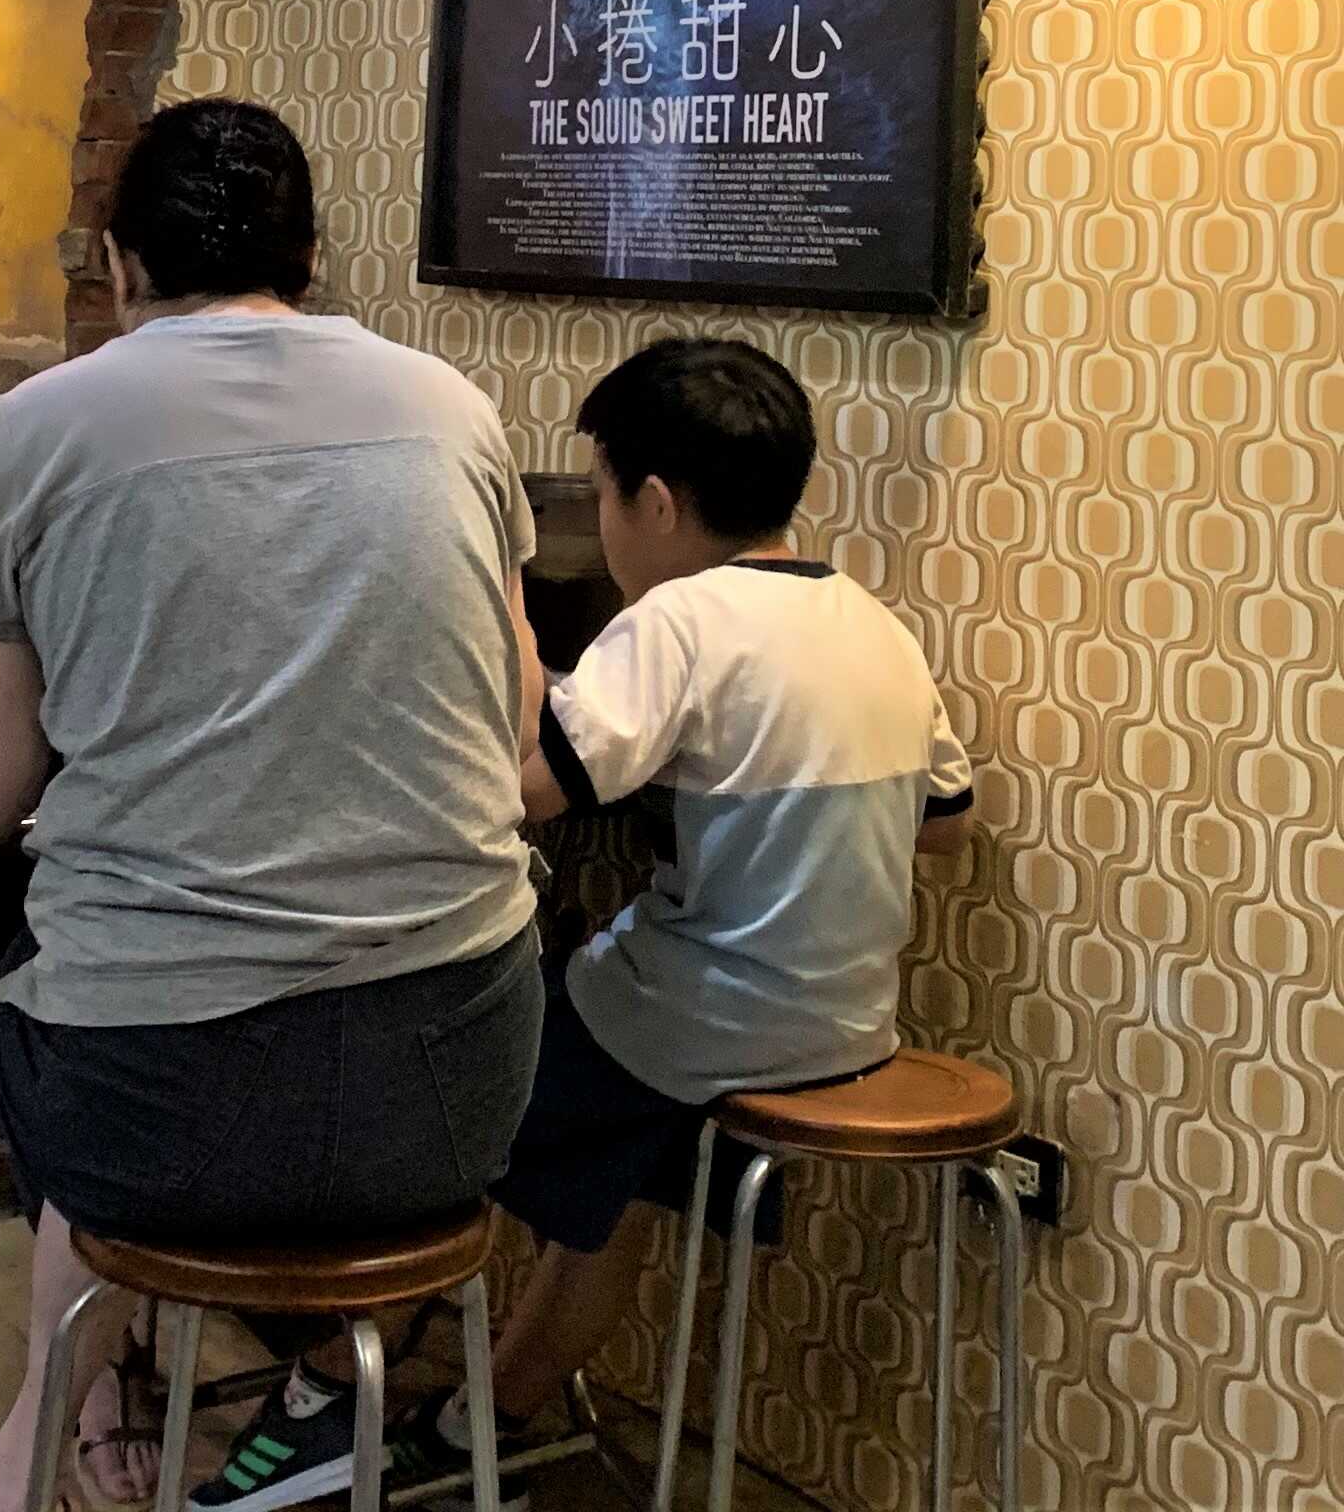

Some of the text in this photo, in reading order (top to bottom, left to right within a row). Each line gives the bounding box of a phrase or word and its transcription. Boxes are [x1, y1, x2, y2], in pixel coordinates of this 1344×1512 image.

[529, 91, 830, 146] THE SQUID SWEET HEART
